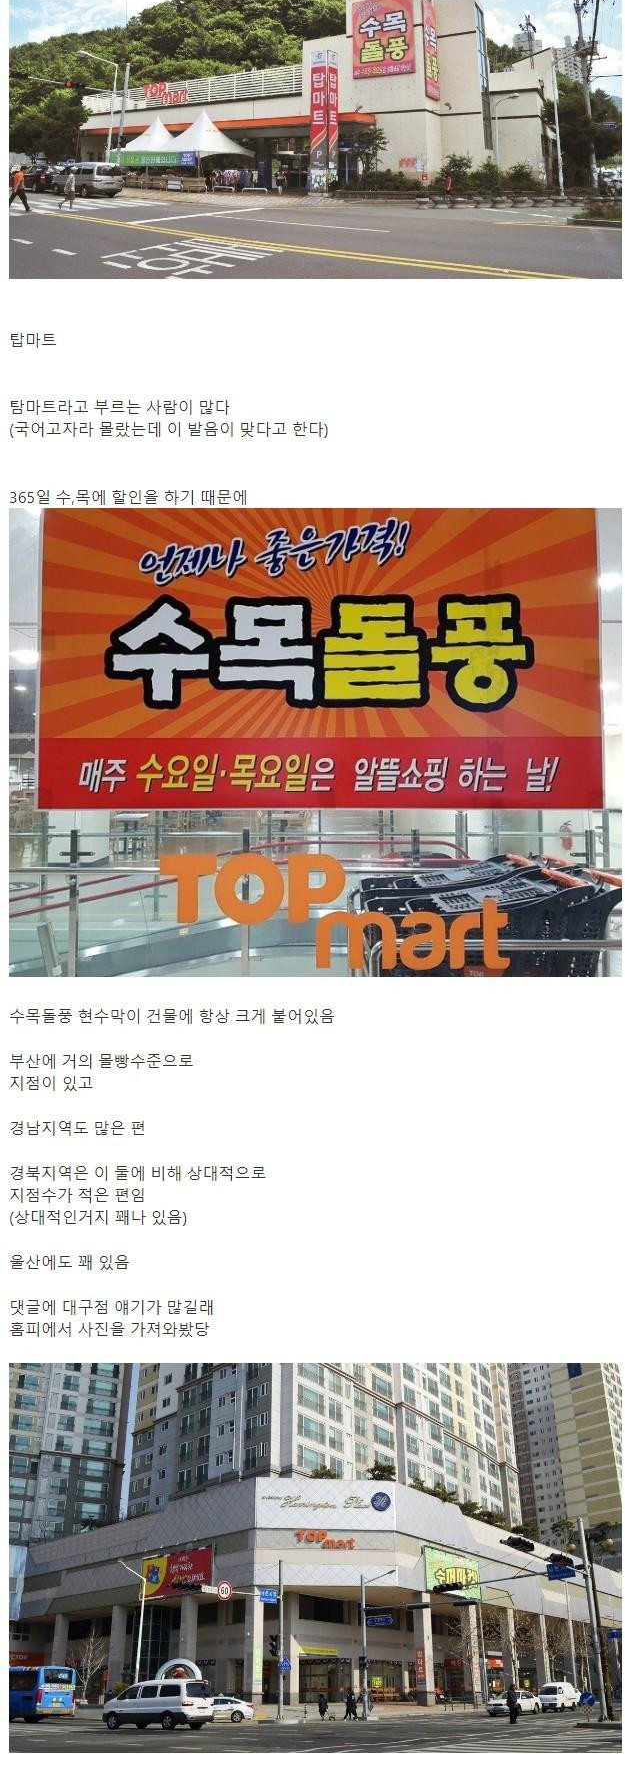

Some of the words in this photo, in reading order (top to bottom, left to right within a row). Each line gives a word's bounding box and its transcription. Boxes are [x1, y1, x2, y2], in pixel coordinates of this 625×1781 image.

[359, 10, 407, 38] 수목
[360, 36, 409, 63] 돌풍
[143, 81, 168, 99] TOP
[160, 88, 188, 104] mart
[312, 72, 325, 125] 탑마트
[329, 73, 337, 125] 탑마트
[316, 150, 323, 160] P
[139, 537, 246, 585] 언제나
[255, 518, 411, 578] 좋은가격!
[106, 594, 534, 711] 수목돌풍
[79, 758, 127, 793] 매주
[354, 756, 449, 793] 알뜰쇼핑
[458, 756, 507, 792] 하는
[526, 756, 560, 793] 날!
[160, 853, 346, 924] TOP
[315, 900, 510, 971] mart
[295, 1529, 328, 1543] TOP
[321, 1537, 355, 1549] mart
[220, 1586, 229, 1595] 60
